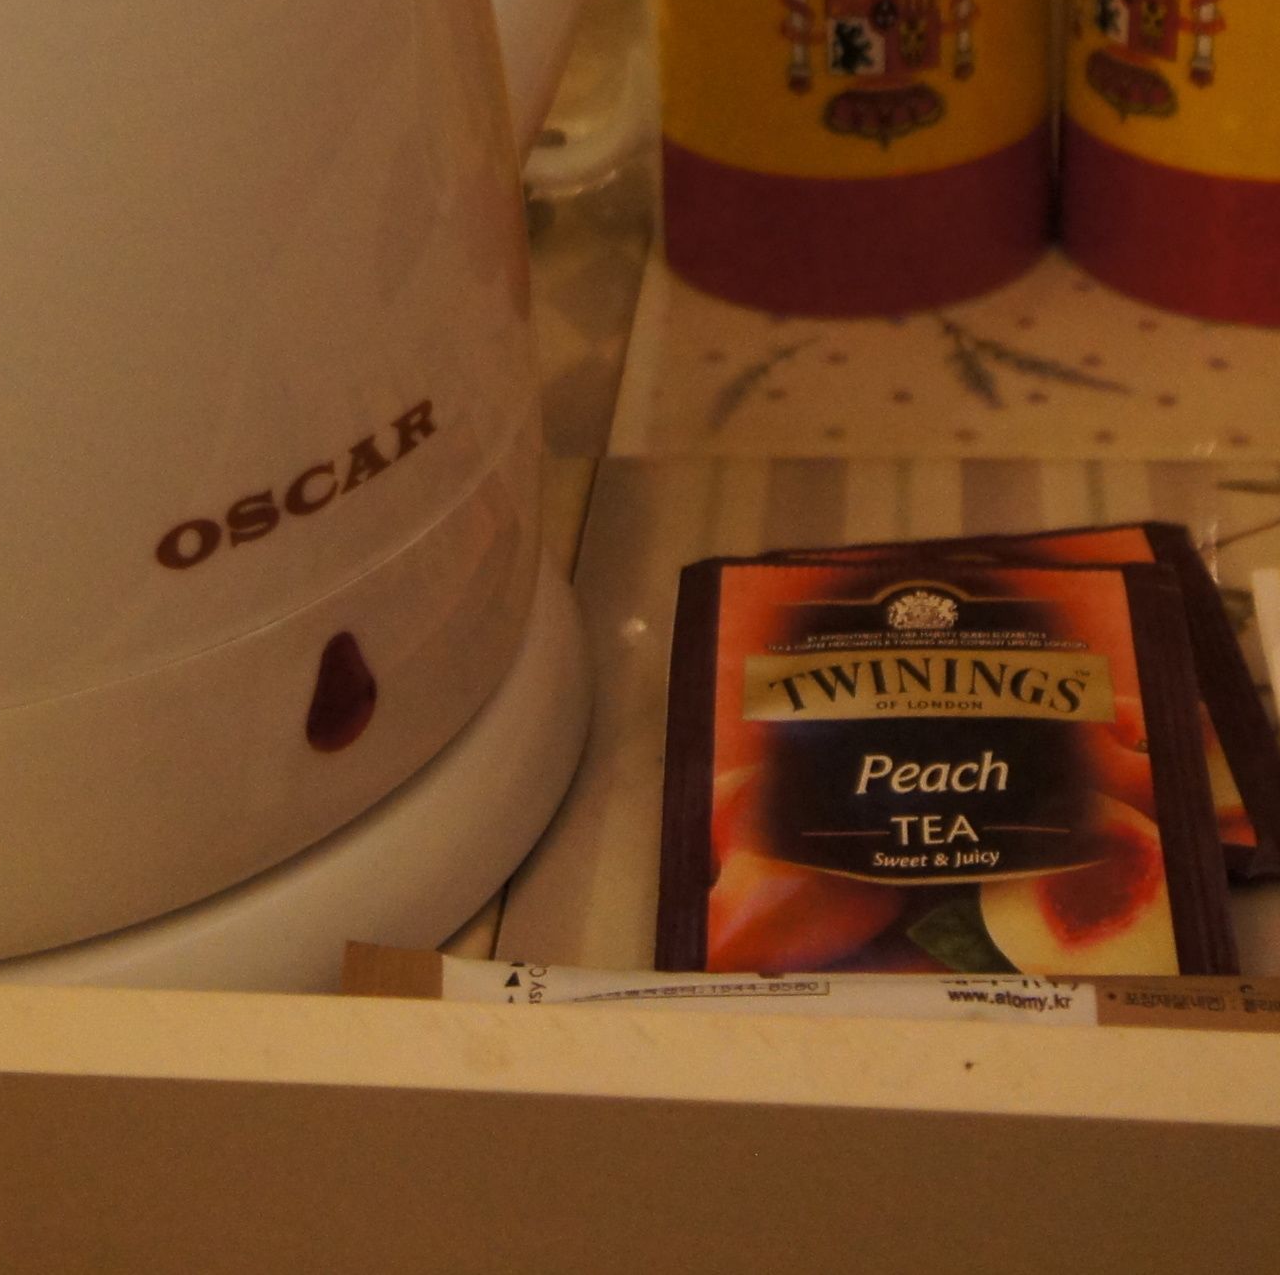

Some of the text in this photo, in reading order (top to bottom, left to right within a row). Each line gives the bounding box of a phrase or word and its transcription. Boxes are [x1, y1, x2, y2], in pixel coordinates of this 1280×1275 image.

[154, 399, 437, 570] OSCAR
[768, 656, 1087, 714] TWININGS
[875, 700, 983, 710] OF LONDON
[854, 750, 1009, 795] Peach
[890, 814, 980, 846] TEA
[873, 848, 1000, 868] Sweet & Juicy
[947, 989, 1072, 1012] www.atomy.kr
